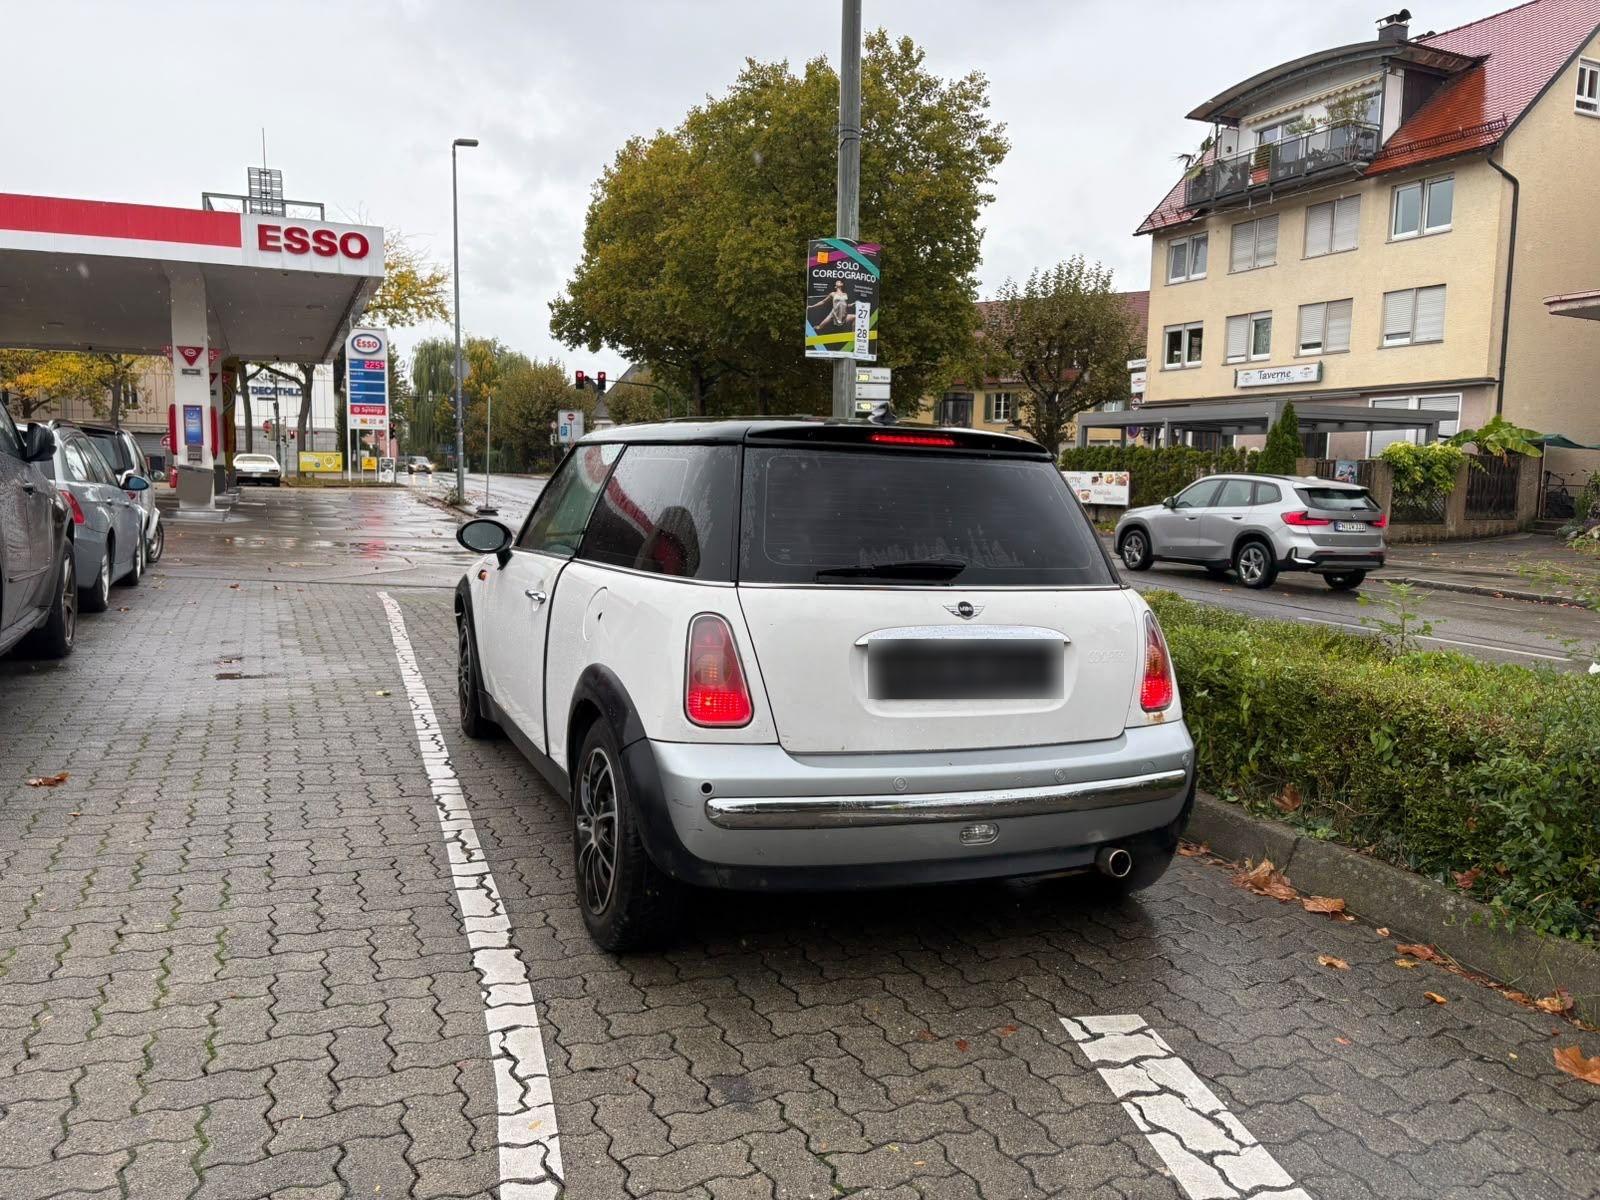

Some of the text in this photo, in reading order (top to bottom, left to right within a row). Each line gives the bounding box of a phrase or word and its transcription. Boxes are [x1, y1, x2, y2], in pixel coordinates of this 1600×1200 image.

[258, 224, 369, 259] ESSO
[836, 260, 860, 271] SOLO
[812, 269, 877, 283] COREOGRAFICO
[858, 309, 869, 320] 27
[856, 328, 868, 339] 28
[1258, 369, 1292, 380] Taverne
[251, 386, 303, 397] DECATHLO
[361, 406, 384, 417] Synergy
